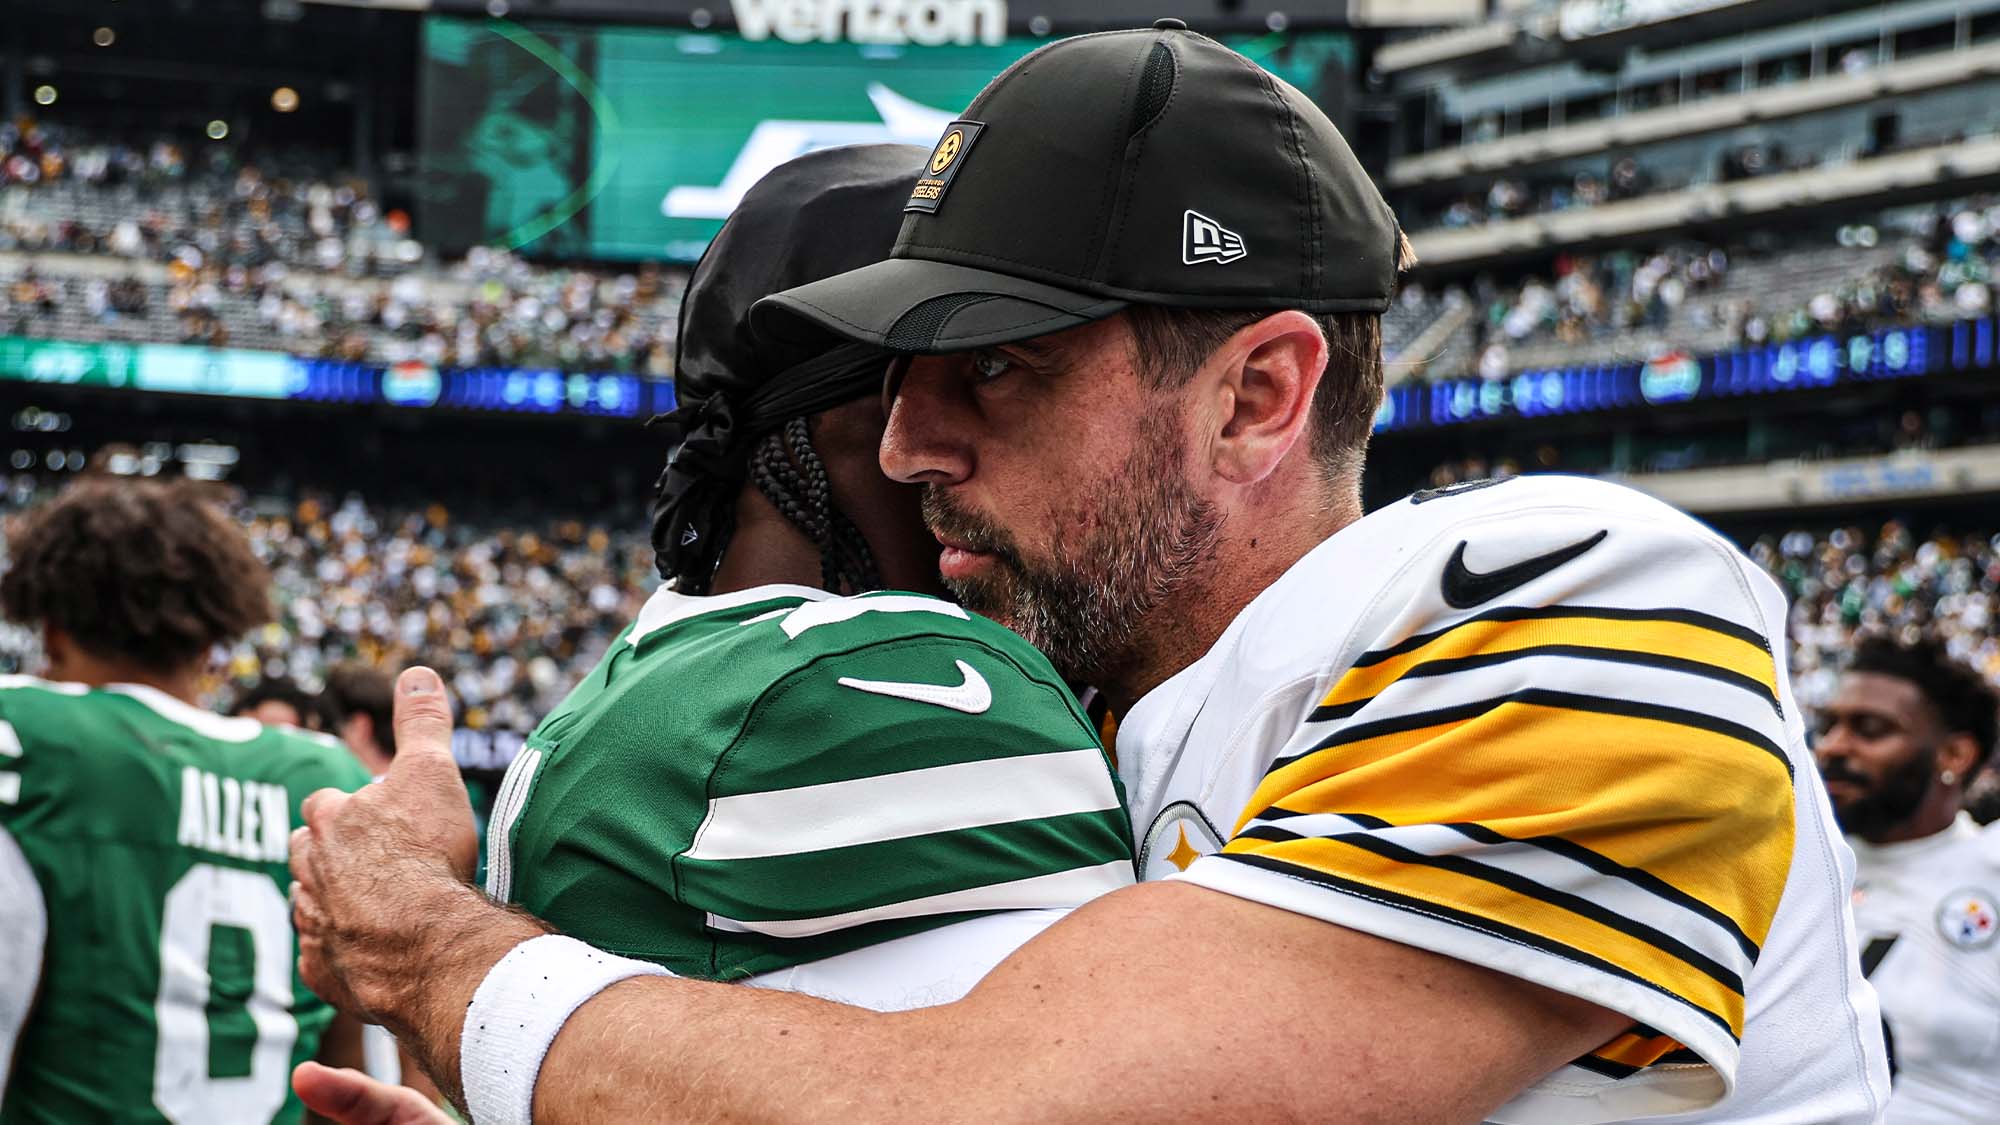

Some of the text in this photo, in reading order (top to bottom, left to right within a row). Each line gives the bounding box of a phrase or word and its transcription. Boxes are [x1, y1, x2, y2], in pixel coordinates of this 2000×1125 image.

[731, 0, 1008, 46] verizon
[912, 186, 941, 199] STEELERS
[177, 766, 290, 864] ALLEN
[152, 862, 299, 1125] 0
